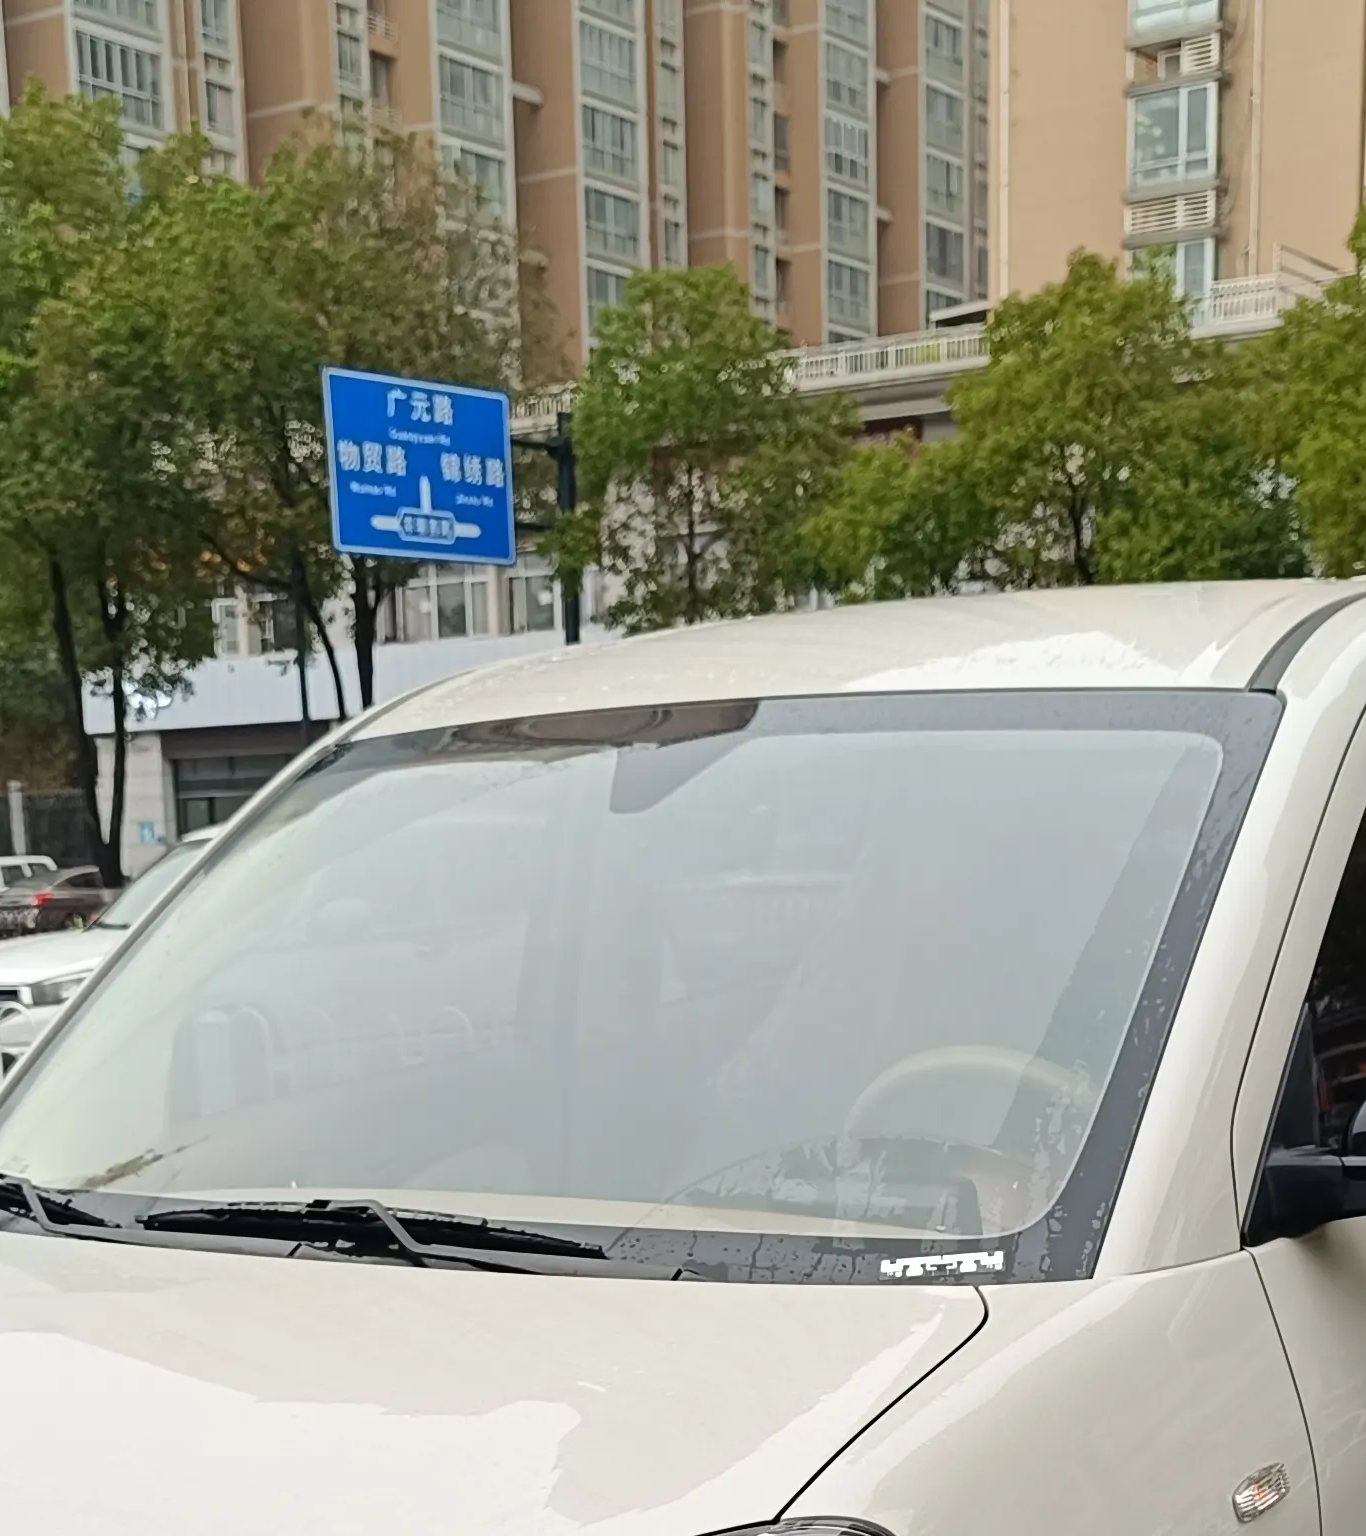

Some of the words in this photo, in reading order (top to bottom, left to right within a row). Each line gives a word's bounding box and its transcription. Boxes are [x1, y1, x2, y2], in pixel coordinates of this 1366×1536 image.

[387, 388, 453, 425] 广元路
[337, 440, 406, 476] 物贸路
